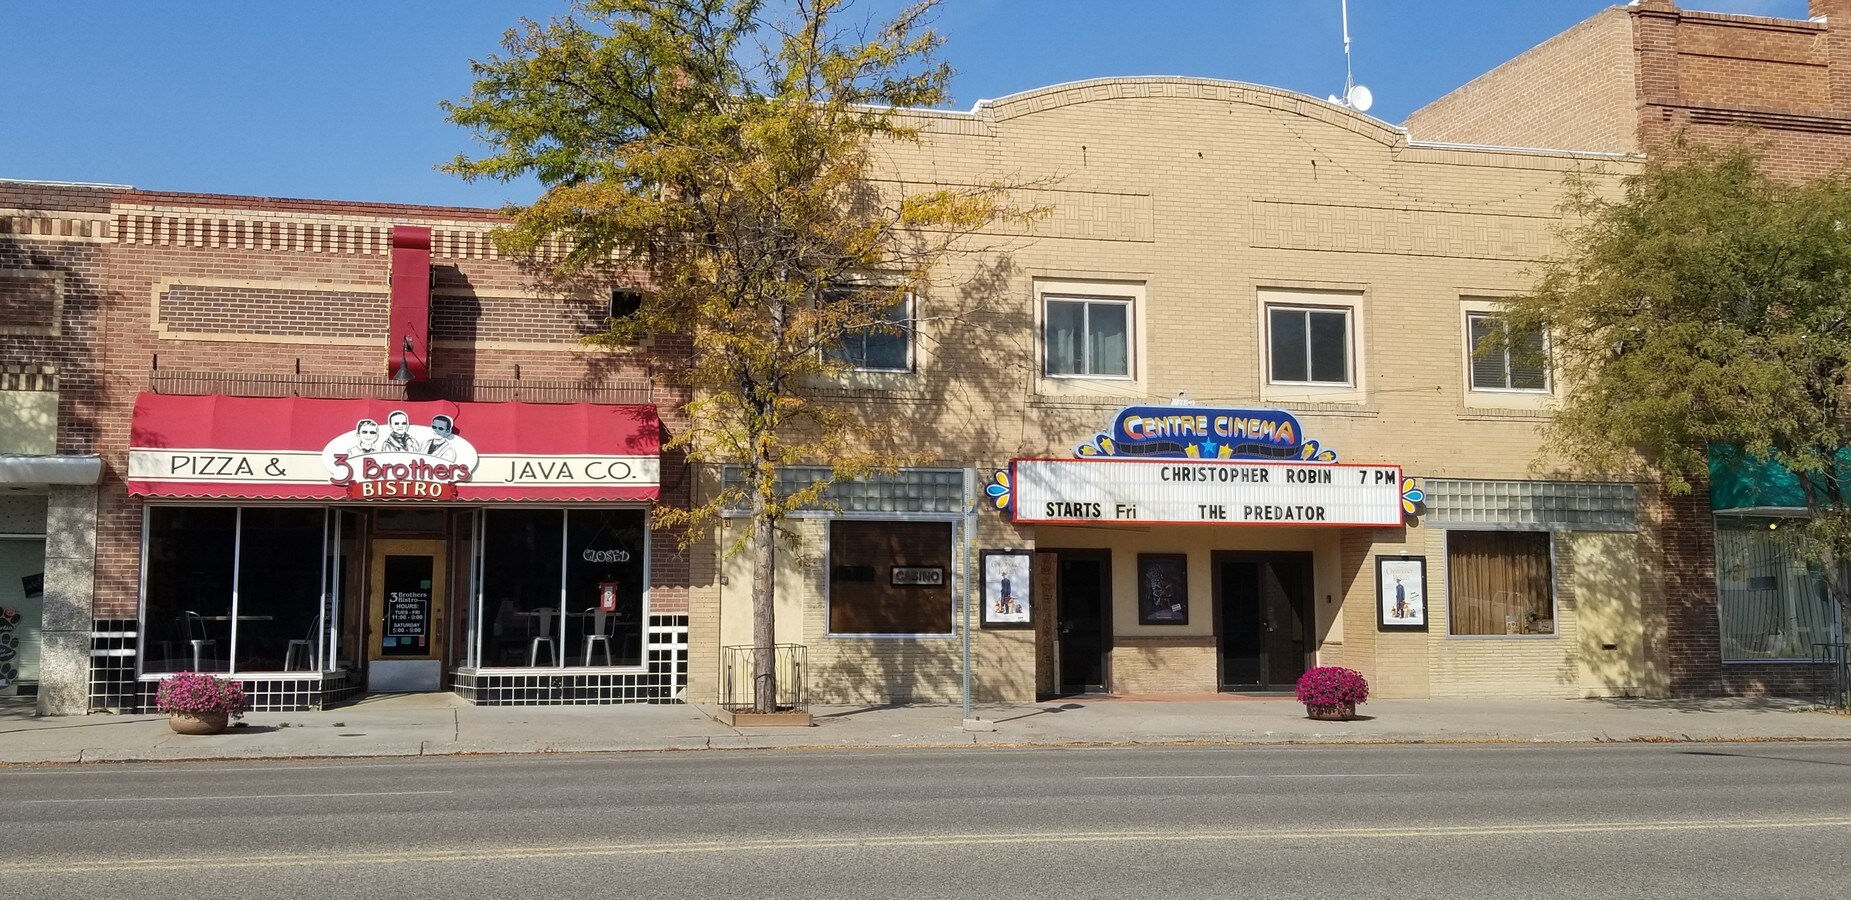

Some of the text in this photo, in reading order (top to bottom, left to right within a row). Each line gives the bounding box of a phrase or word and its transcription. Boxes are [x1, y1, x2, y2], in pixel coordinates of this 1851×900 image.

[1123, 415, 1295, 445] CENTRE CINEMA
[171, 456, 286, 476] PIZZA &
[330, 453, 470, 485] 3 Brothers
[504, 461, 637, 482] JAVA CO.
[1160, 466, 1396, 485] CHRISTOPHER ROBIN 7 PM
[362, 481, 442, 497] BISTRO
[1046, 501, 1136, 519] STARTS Fri
[1198, 504, 1325, 521] THE PREDATOR
[582, 548, 630, 563] CLOSED
[895, 570, 940, 581] CASINO
[389, 592, 398, 603] 3
